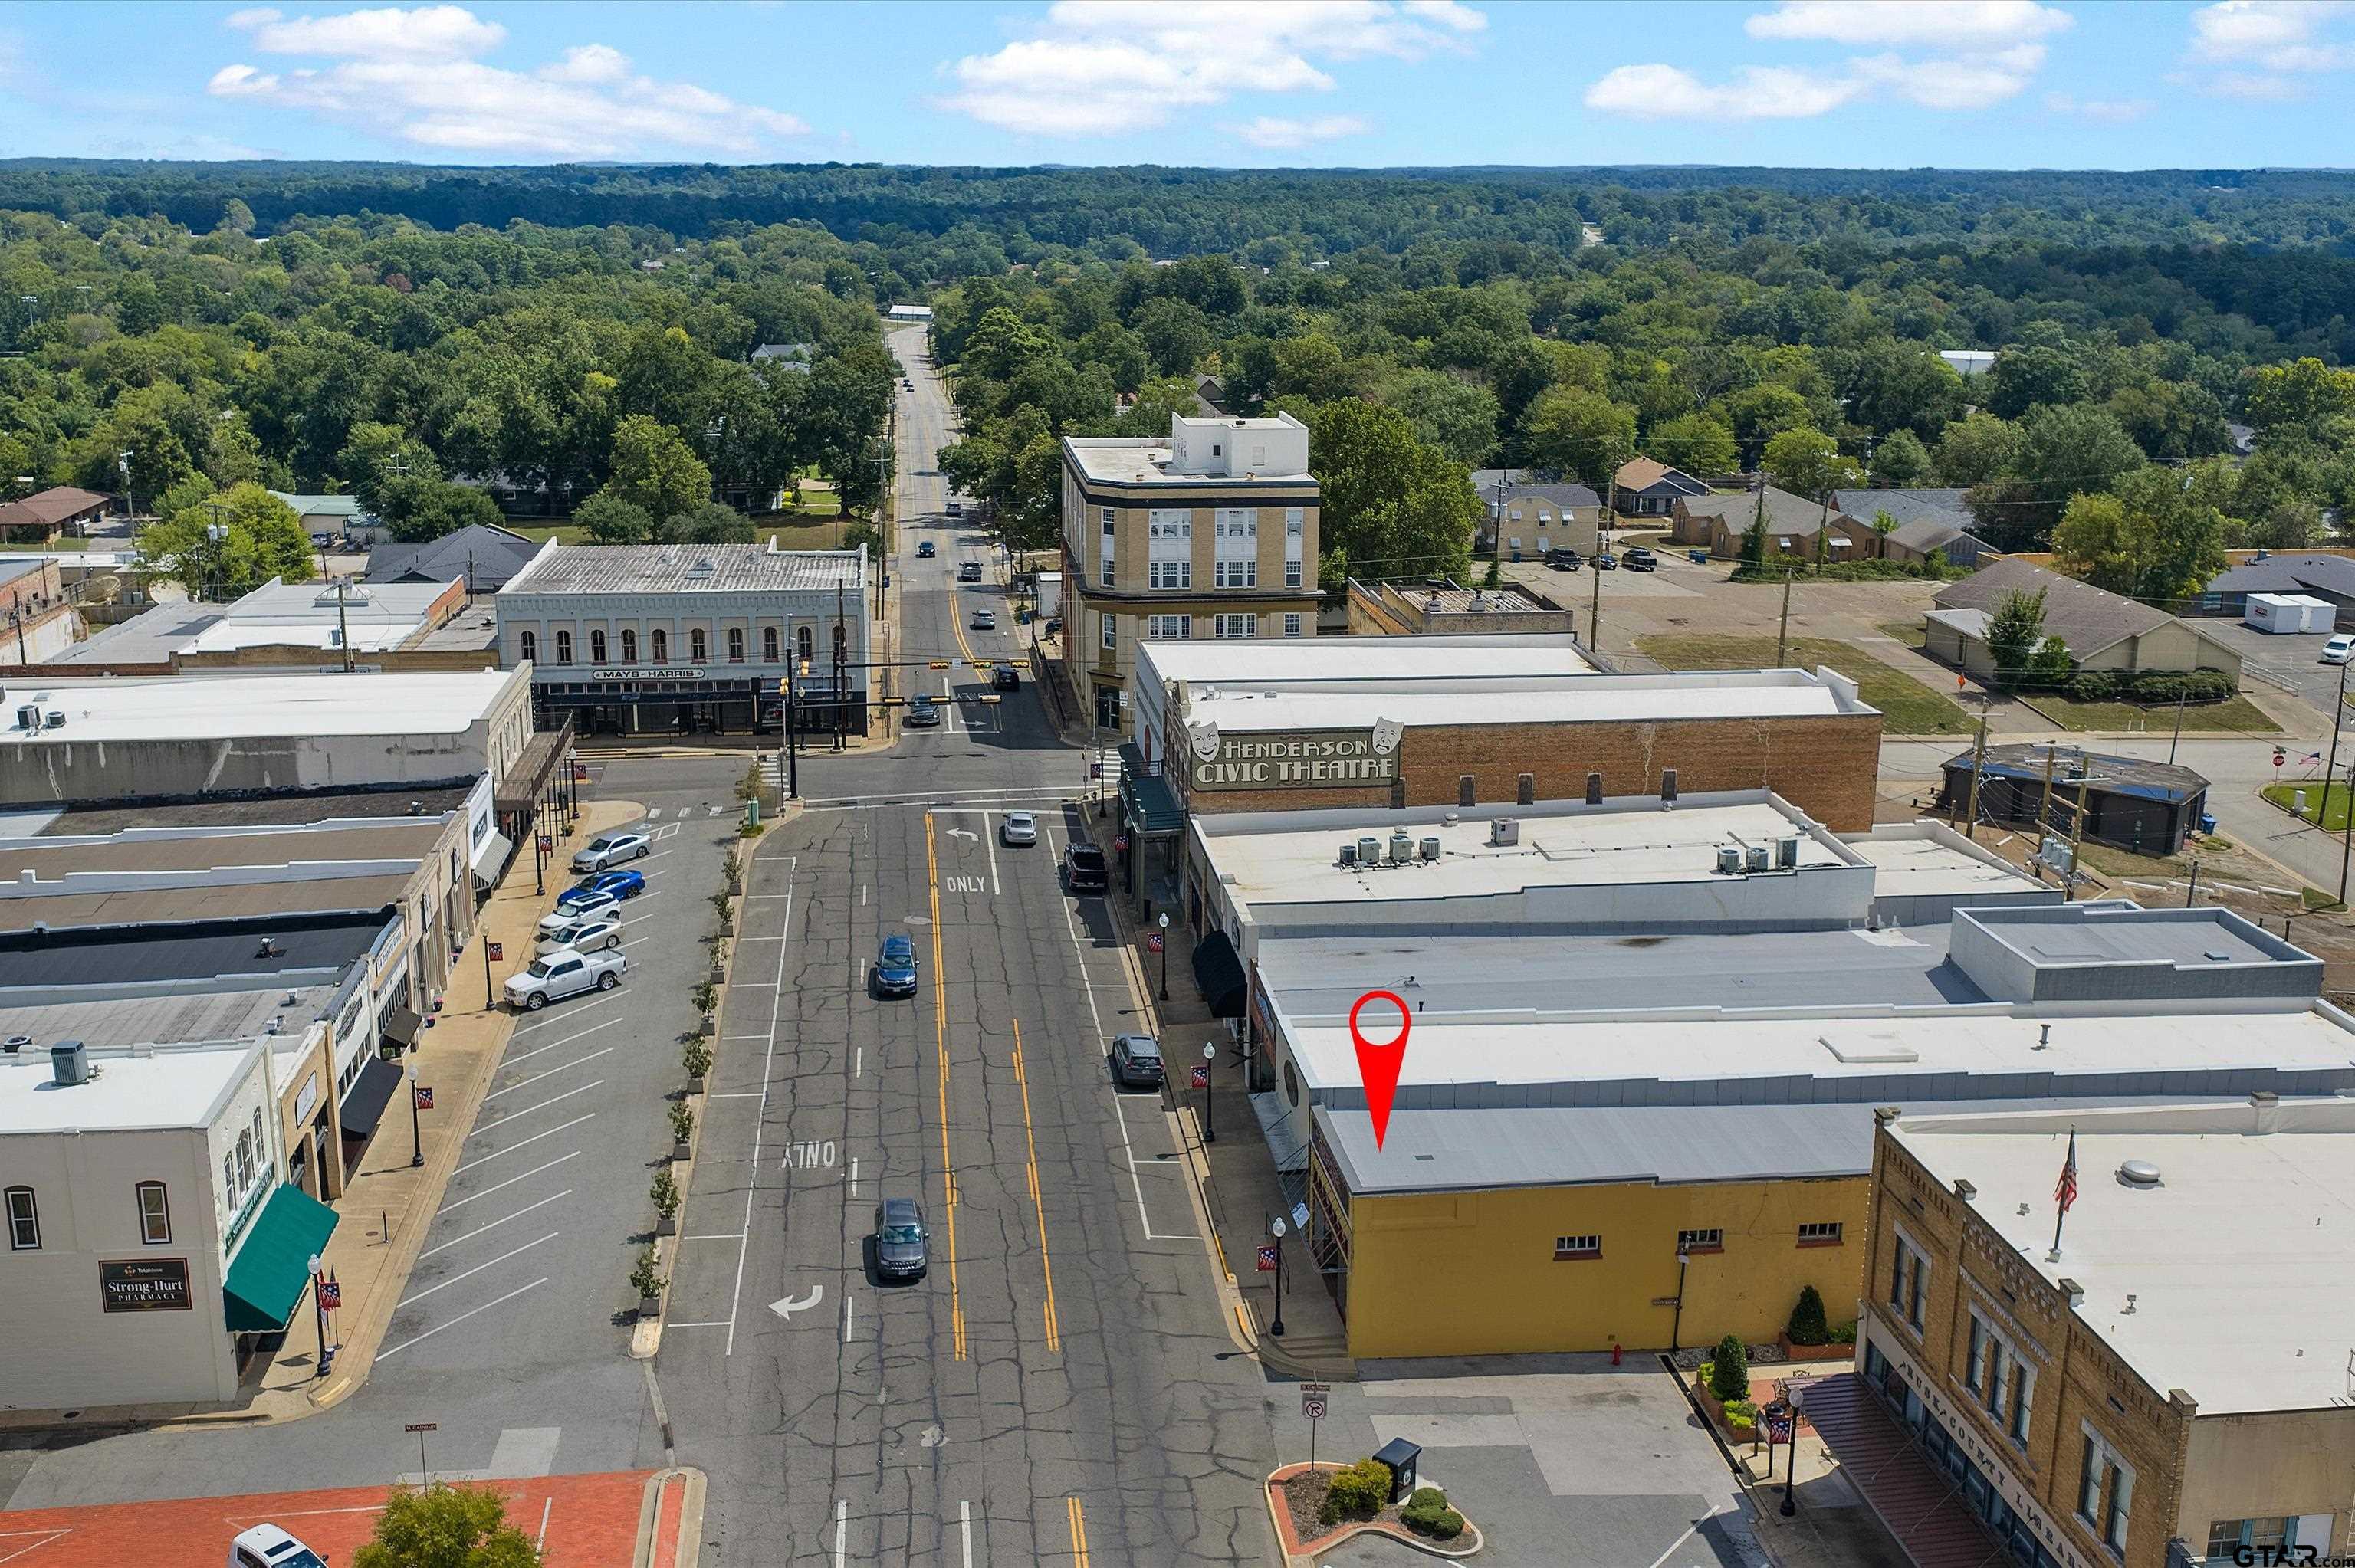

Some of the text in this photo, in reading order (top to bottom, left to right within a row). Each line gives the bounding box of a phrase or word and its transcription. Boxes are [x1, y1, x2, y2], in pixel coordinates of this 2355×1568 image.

[1223, 740, 1368, 759] HENDERSON
[1197, 758, 1393, 783] CIVIC THEATRE
[946, 876, 985, 892] ONLY
[781, 1140, 836, 1169] ONLY
[117, 1293, 176, 1301] PHARMACY
[1907, 1363, 2084, 1568] RUSK COUNTY LIBRAR
